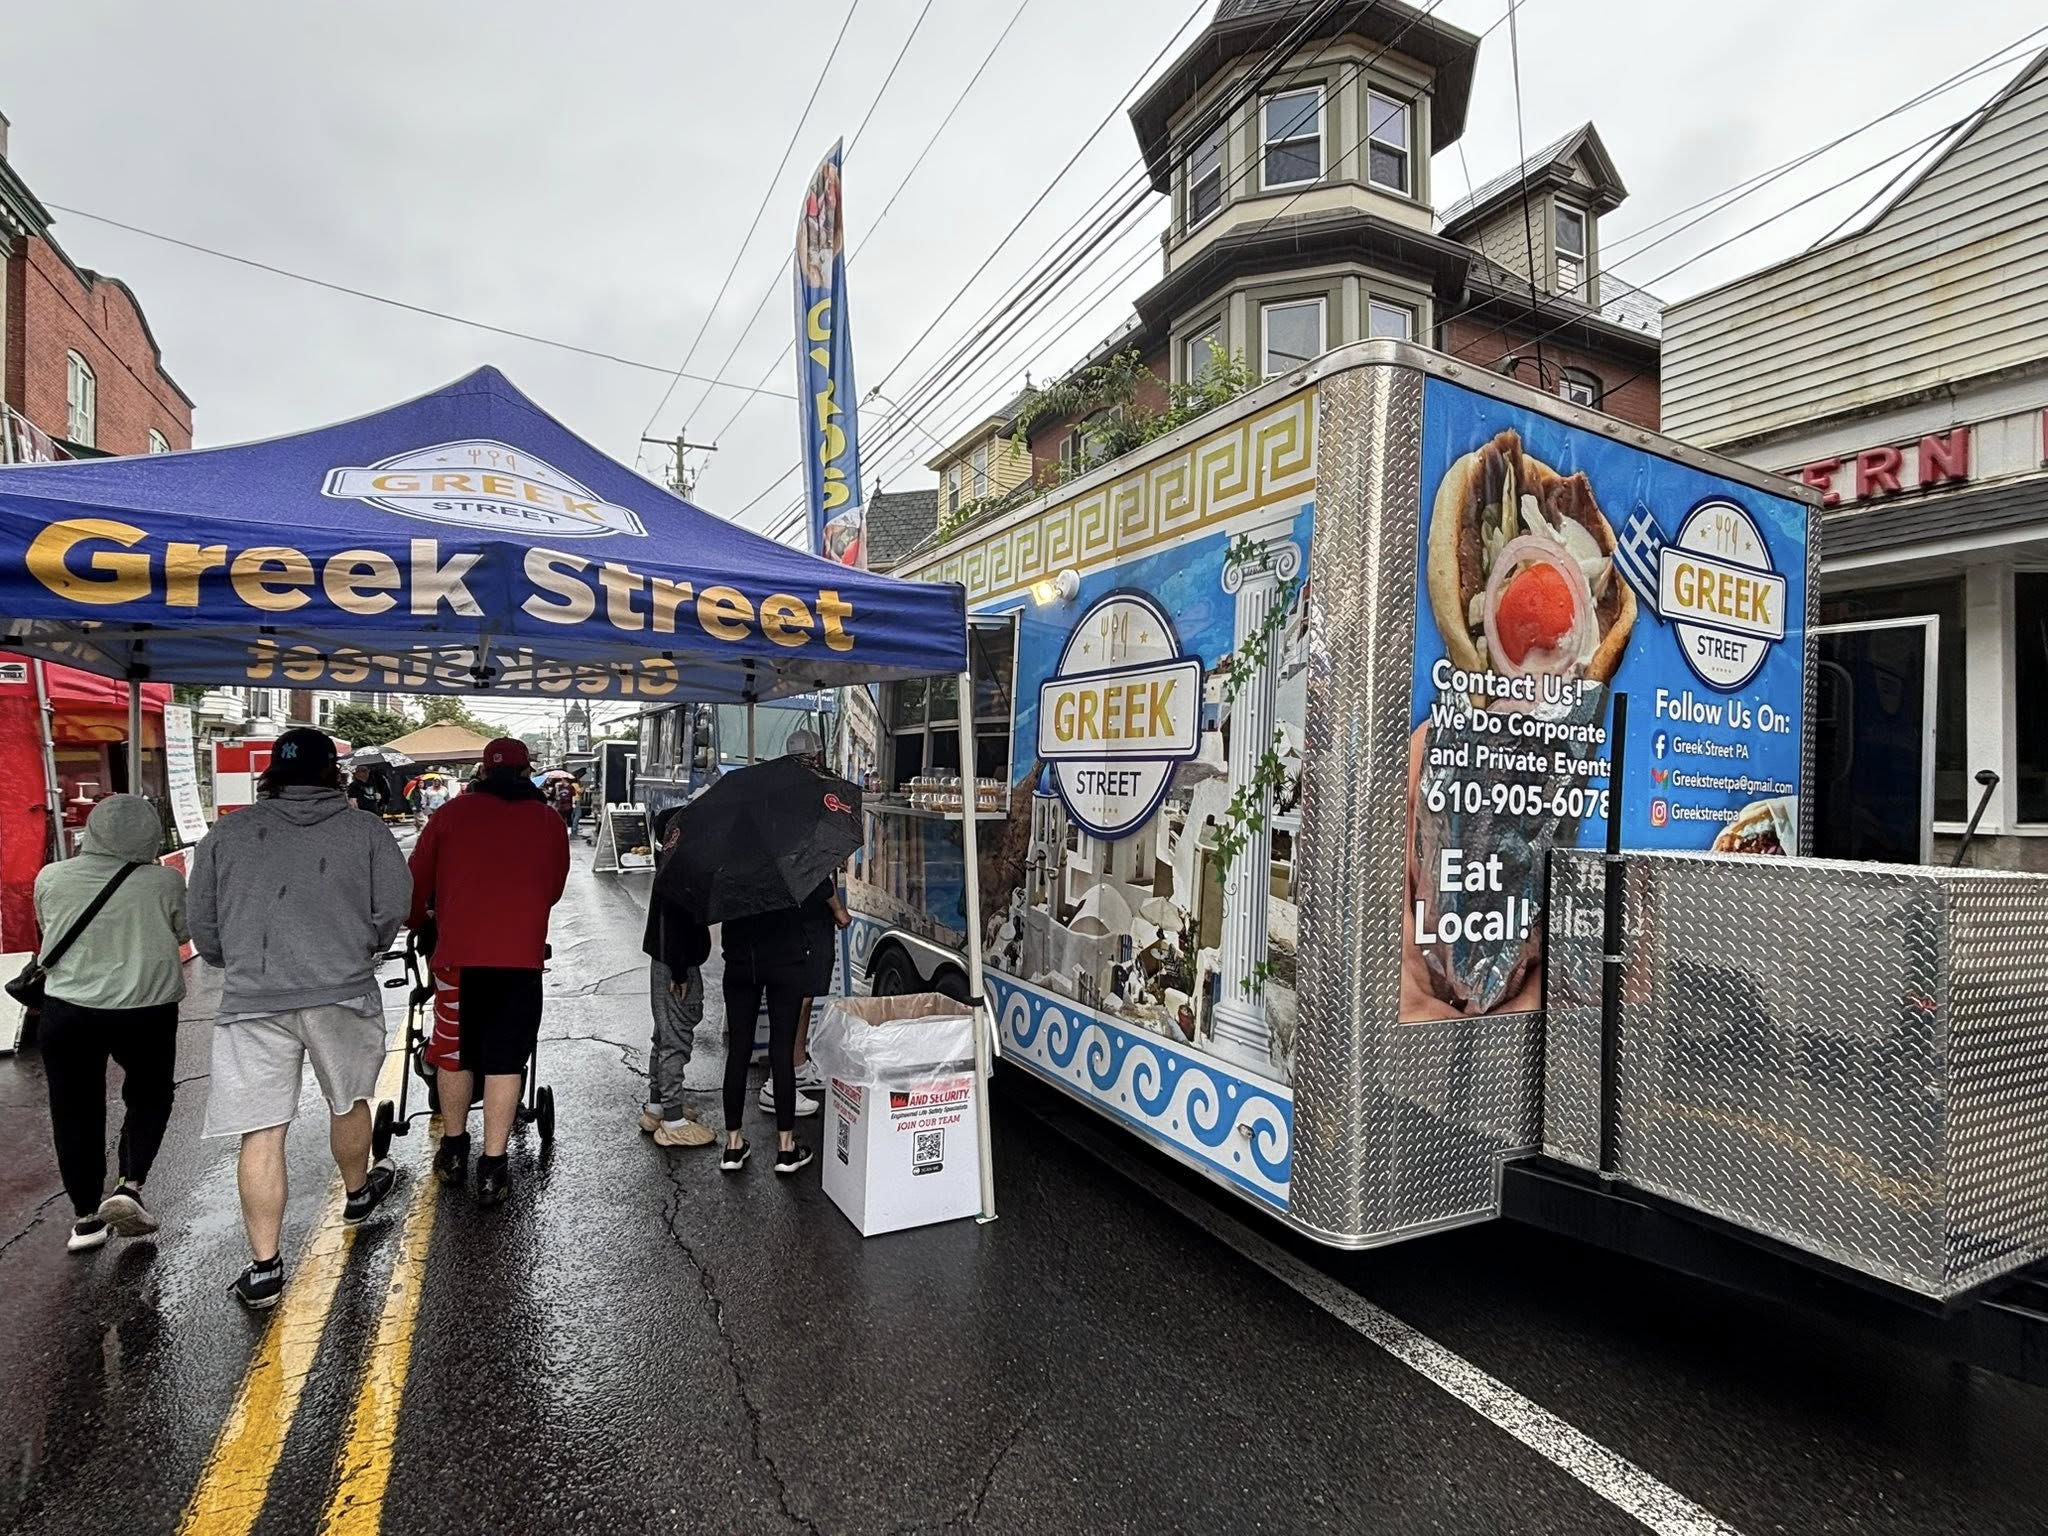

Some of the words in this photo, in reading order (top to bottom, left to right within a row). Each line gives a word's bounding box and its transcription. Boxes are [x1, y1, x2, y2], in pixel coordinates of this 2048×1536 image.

[372, 474, 604, 522] GREEK
[432, 501, 560, 525] STREET
[25, 518, 485, 617] Greek
[521, 547, 855, 651] Street
[1674, 563, 1771, 624] GREEK
[1697, 635, 1747, 663] STREET
[1432, 659, 1535, 700] Contact
[1544, 673, 1583, 706] Us!
[1054, 678, 1178, 742] GREEK
[1432, 704, 1465, 730] We
[1472, 709, 1501, 734] Do
[1508, 713, 1606, 744] Corporate
[1655, 688, 1723, 725] Follow
[1728, 700, 1751, 729] Us
[1758, 704, 1790, 733] On:
[1429, 743, 1468, 767] and
[1476, 745, 1548, 772] Private
[1673, 737, 1703, 755] Greek
[1705, 740, 1733, 758] Street
[1736, 744, 1749, 759] PA
[1076, 771, 1142, 797] STREET
[1427, 780, 1610, 819] 610-905-6078
[1672, 770, 1793, 794] Greekstreetpa@gmail.com
[1671, 804, 1739, 824] Greekstreetpa
[1439, 849, 1503, 892] Eat
[1414, 896, 1530, 945] Local!
[909, 1094, 928, 1106] AND
[897, 1120, 917, 1132] JOIN
[918, 1117, 936, 1128] OUR
[939, 1114, 961, 1125] TEAM
